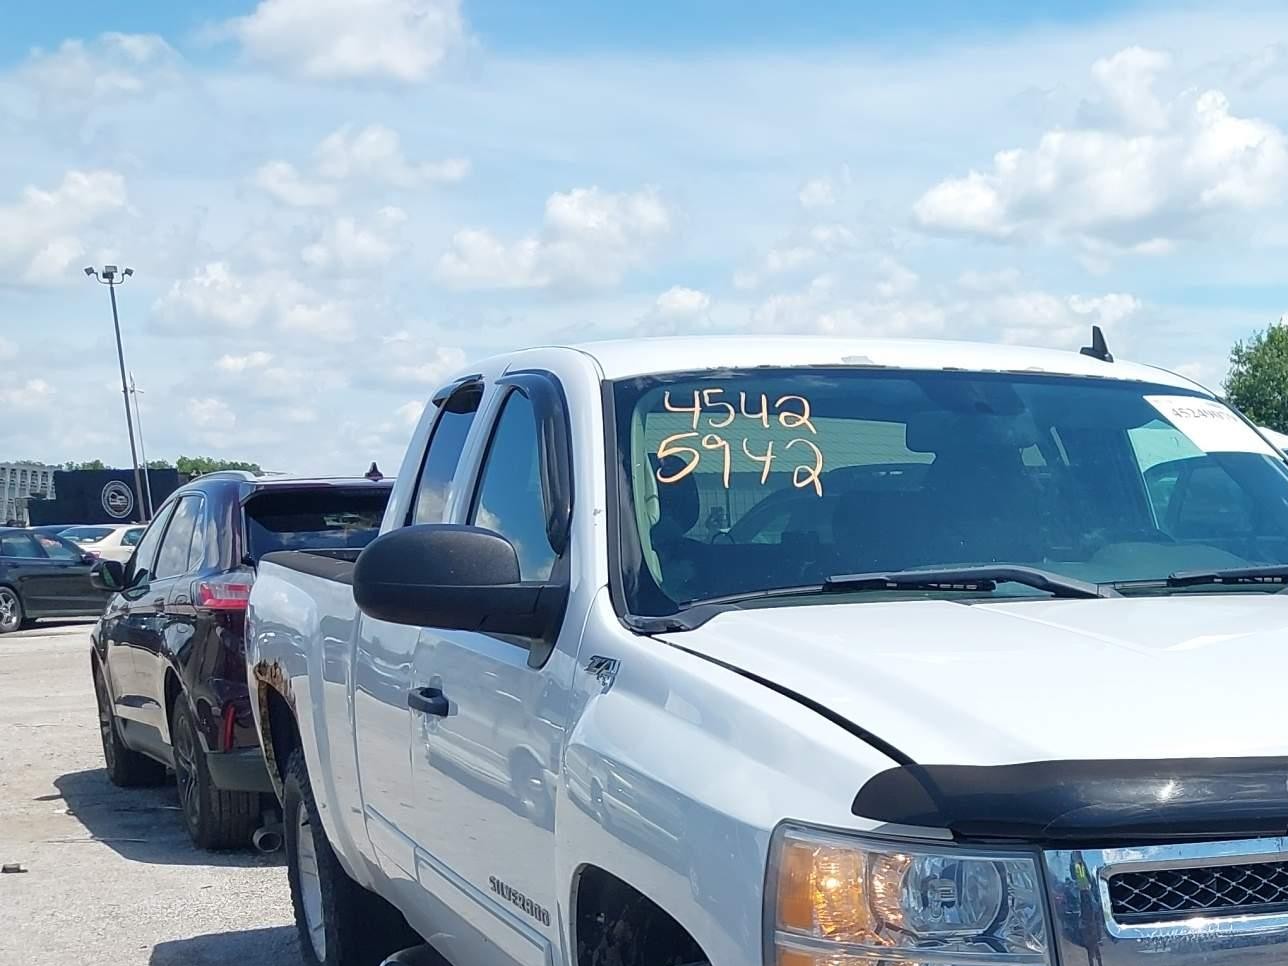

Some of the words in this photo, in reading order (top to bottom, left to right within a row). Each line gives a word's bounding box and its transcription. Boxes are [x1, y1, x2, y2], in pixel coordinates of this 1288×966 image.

[663, 388, 817, 434] 4542
[656, 432, 823, 498] 5942
[488, 875, 550, 927] SILVERADO
